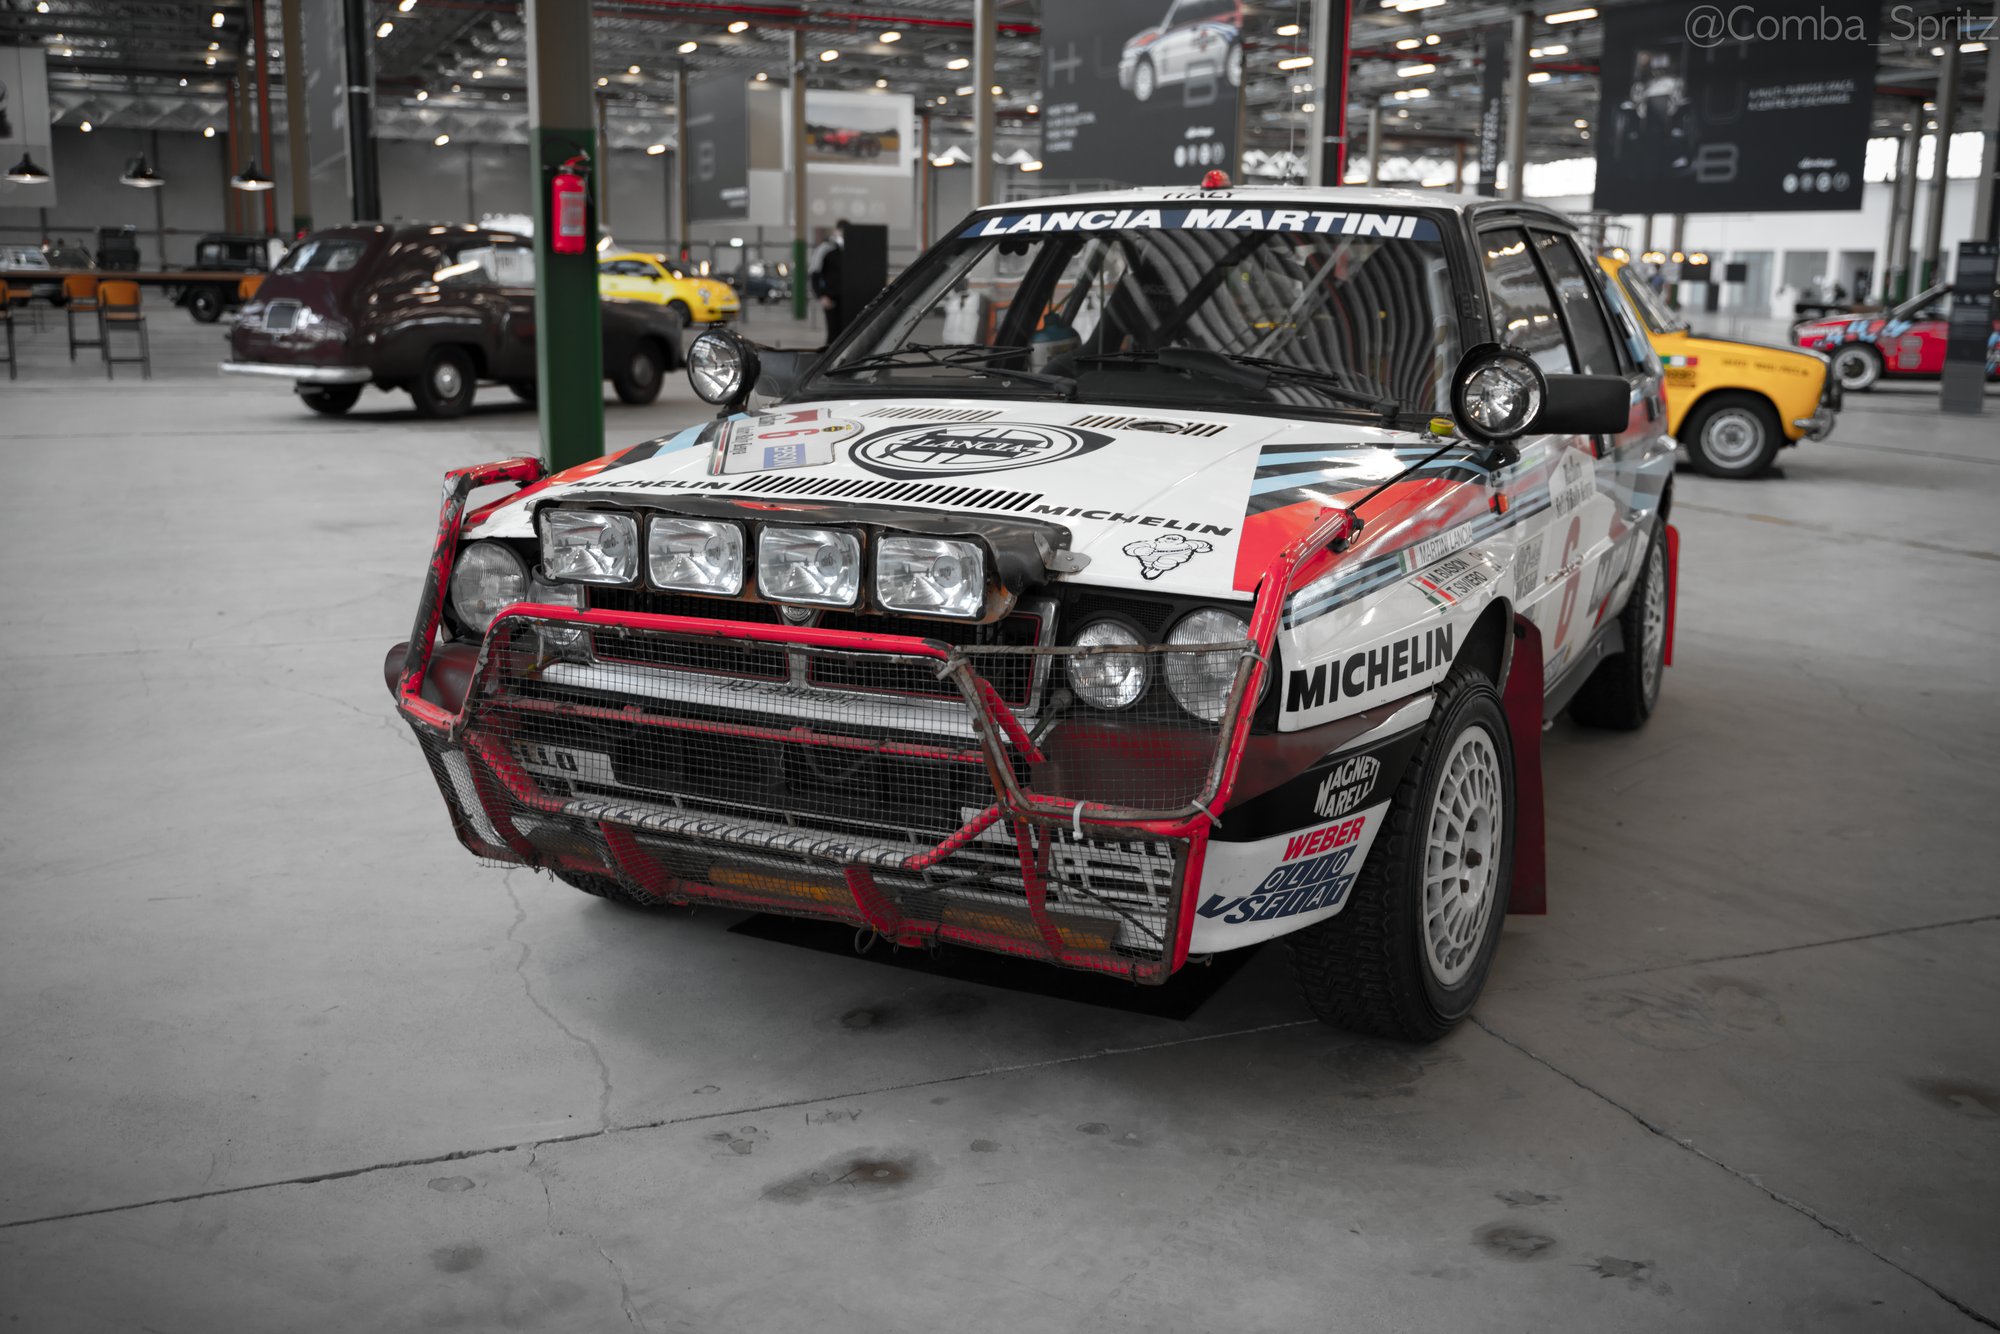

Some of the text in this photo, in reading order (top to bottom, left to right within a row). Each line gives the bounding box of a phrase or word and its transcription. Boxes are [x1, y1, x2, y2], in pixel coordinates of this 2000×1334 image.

[979, 208, 1417, 239] LANCIA MARTINI
[758, 428, 820, 439] 6
[914, 438, 1027, 453] LANCIA
[774, 445, 798, 467] EPSON
[569, 480, 730, 490] MICHELIN
[1031, 504, 1234, 537] MICHELIN
[1419, 524, 1473, 563] MARTINI LANCIA
[1434, 558, 1471, 579] BIASION
[1453, 571, 1488, 594] SIVIERO
[1286, 623, 1453, 712] MICHELIN
[1282, 816, 1366, 862] WEBER
[1257, 847, 1355, 893] OLIO
